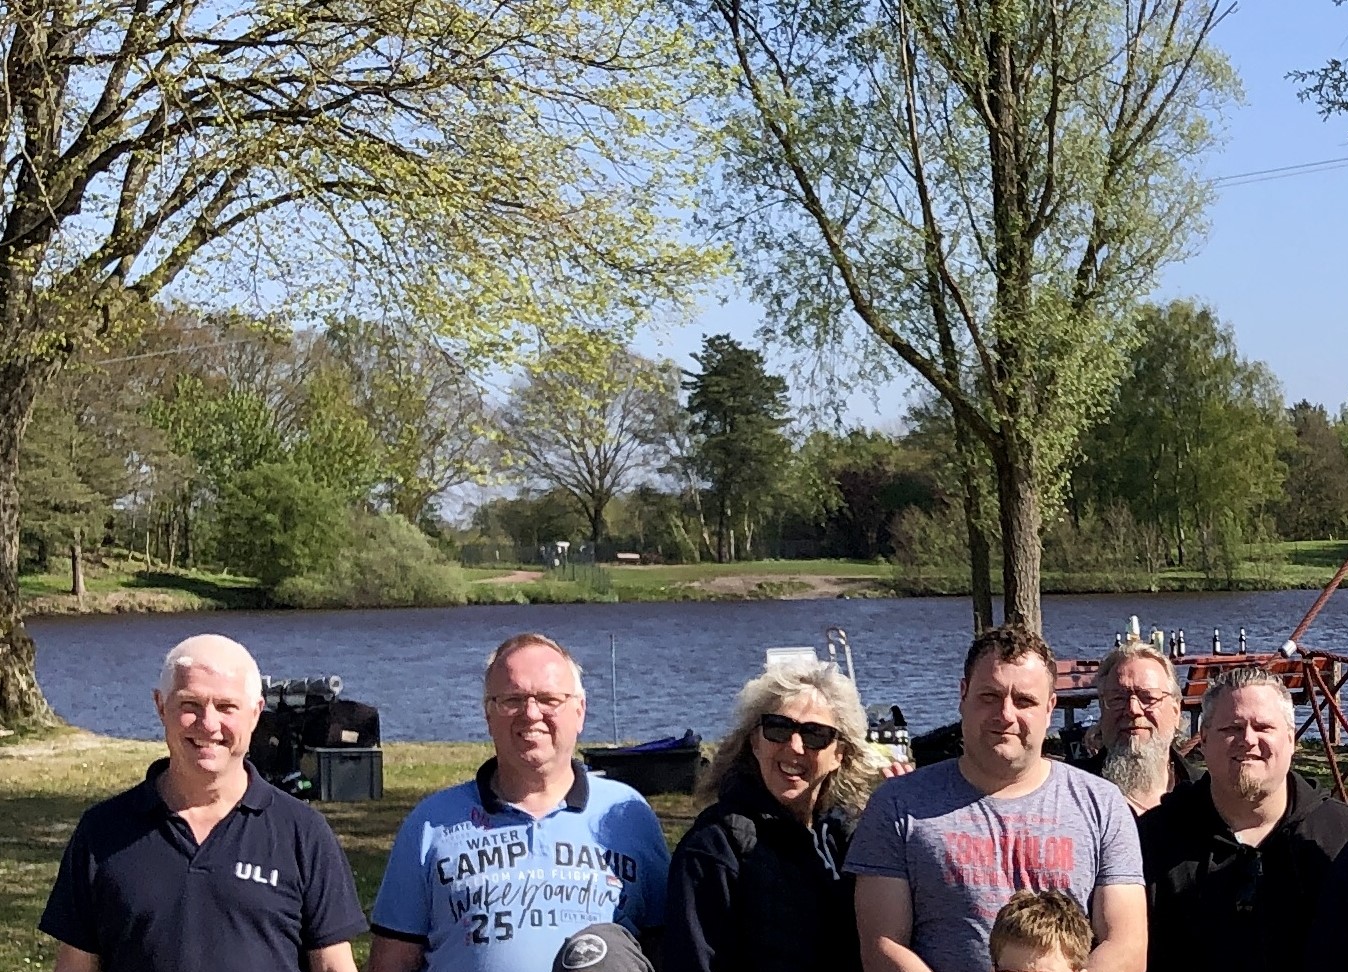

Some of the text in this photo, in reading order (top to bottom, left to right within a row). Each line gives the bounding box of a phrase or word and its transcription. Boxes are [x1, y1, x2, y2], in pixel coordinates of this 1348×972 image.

[466, 829, 520, 850] WATER
[235, 861, 279, 887] ULI
[436, 840, 638, 886] CAMP DAVID
